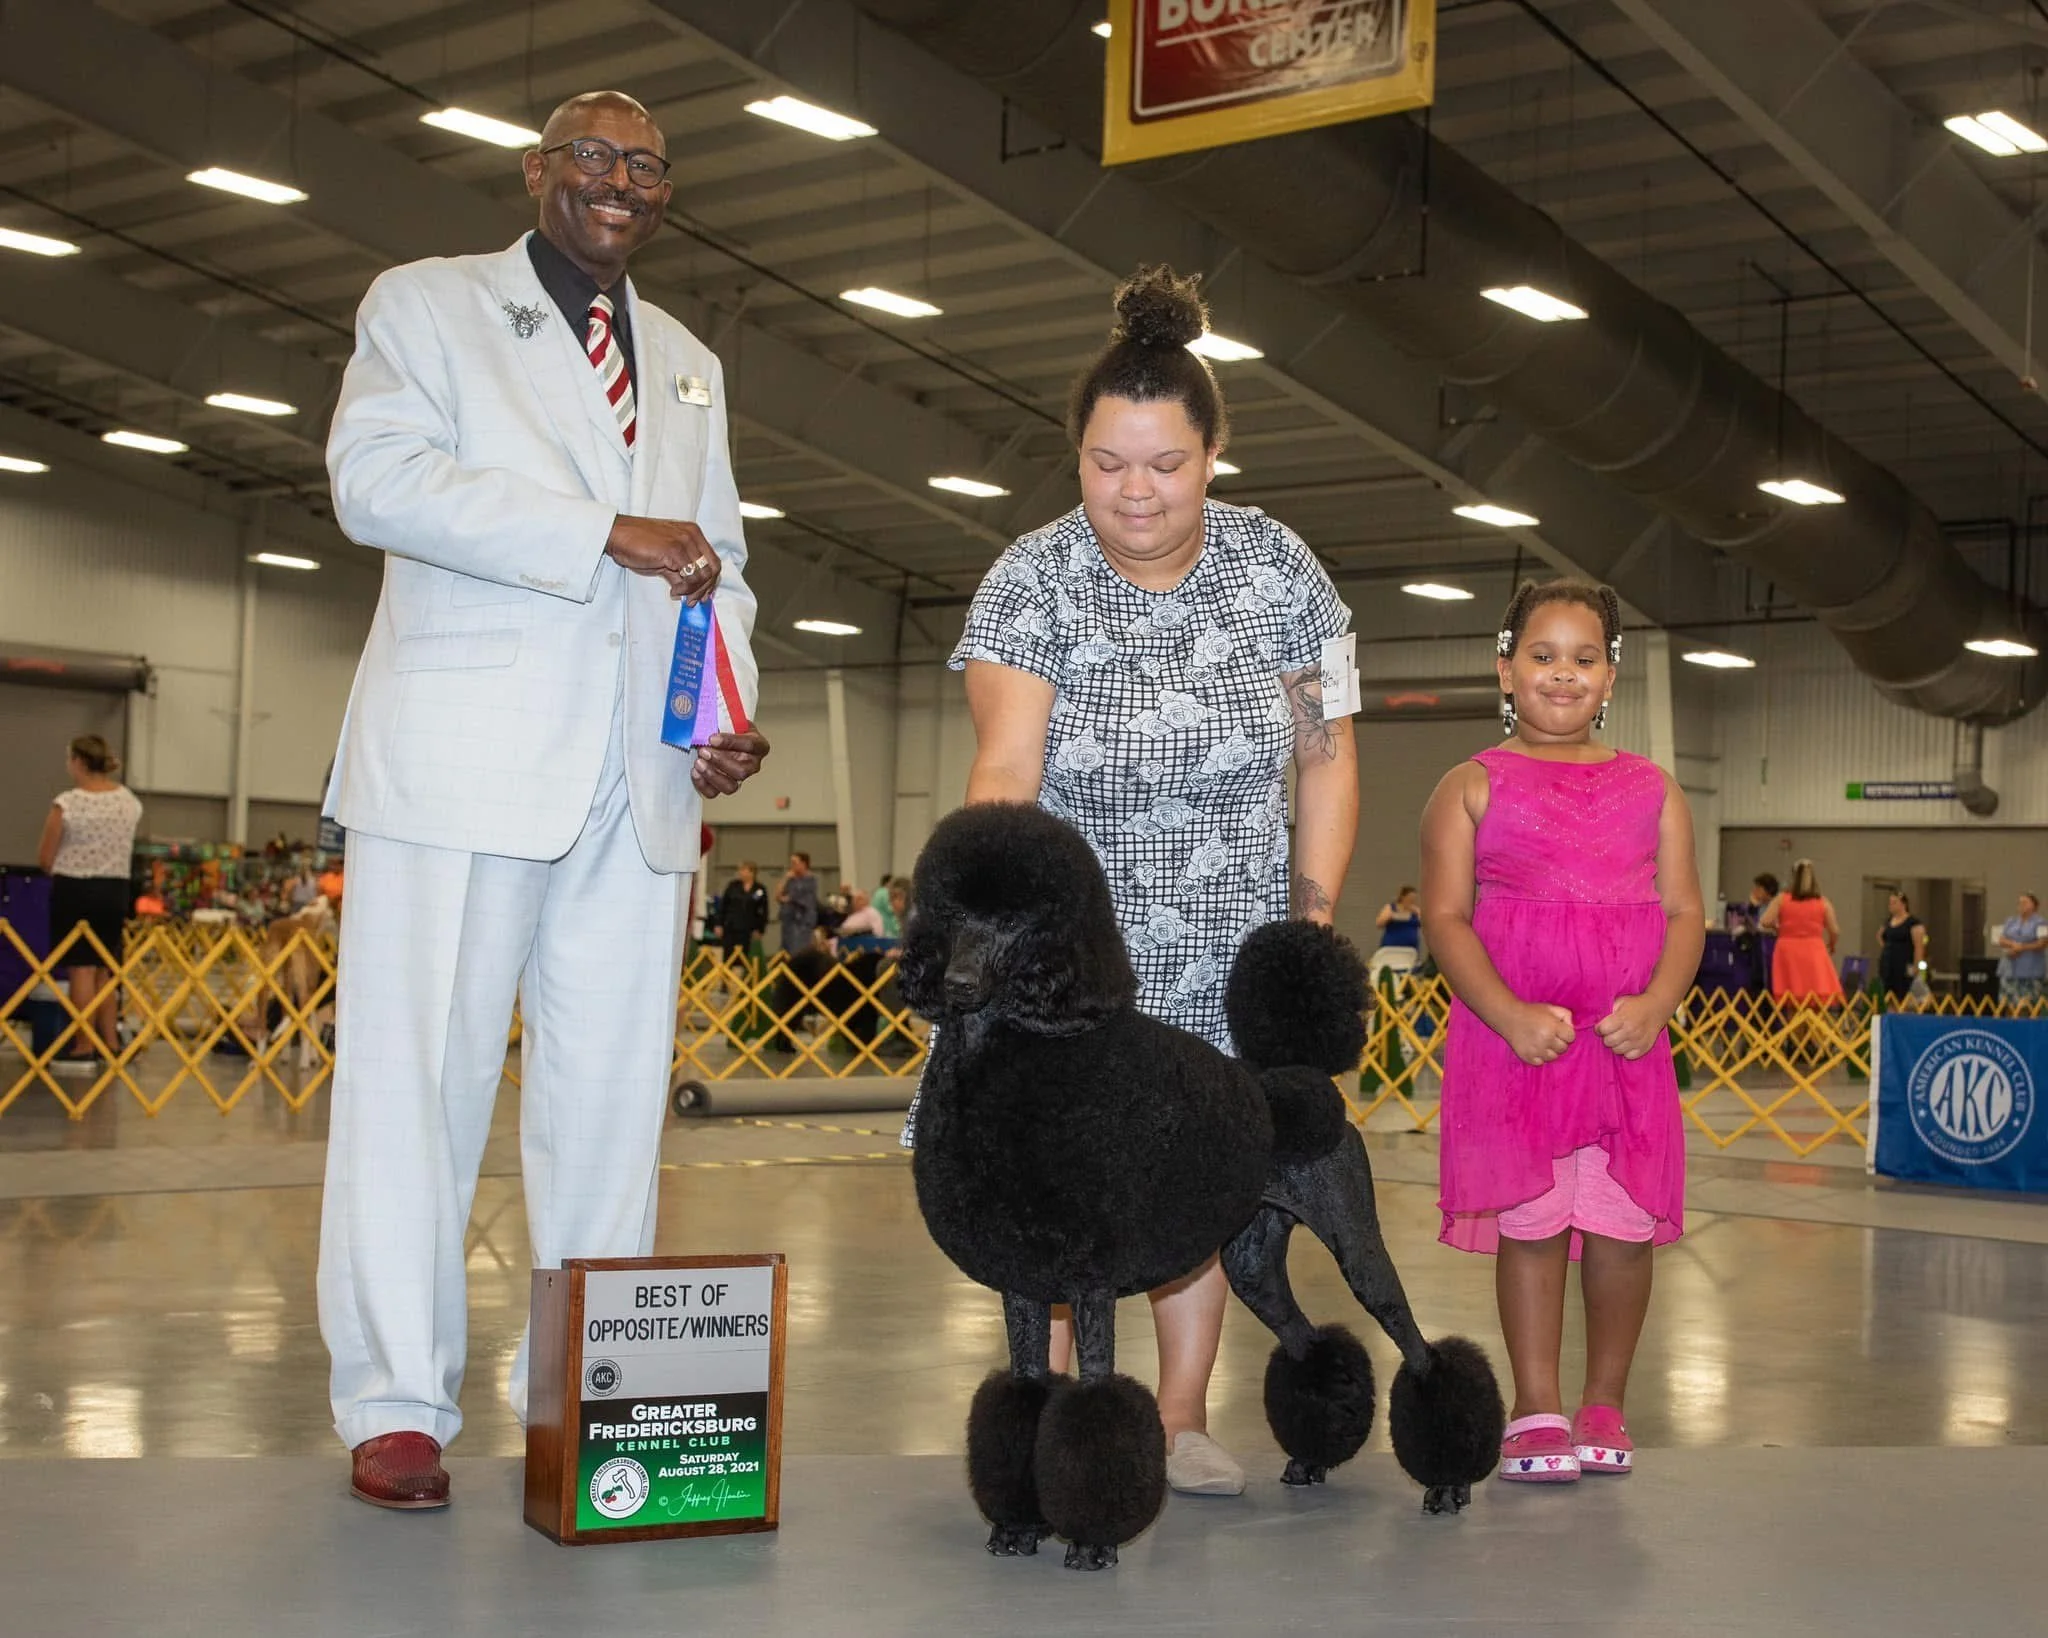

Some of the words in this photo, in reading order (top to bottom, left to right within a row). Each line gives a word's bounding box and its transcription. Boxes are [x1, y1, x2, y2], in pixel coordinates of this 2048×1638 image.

[1248, 12, 1375, 66] CENTER
[1916, 1040, 1962, 1101] AMERICAN
[1965, 1038, 2016, 1072] KENNEL
[2012, 1071, 2027, 1112] CLUB
[1934, 1058, 2005, 1138] AKC
[635, 1285, 692, 1308] BEST
[701, 1284, 728, 1306] OF
[588, 1314, 769, 1342] OPPOSITE/WINNERS
[595, 1371, 612, 1384] AKC
[631, 1403, 717, 1421] GREATER
[589, 1417, 757, 1440] FREDERICKSBURG
[616, 1439, 680, 1452] KENNEL
[688, 1436, 730, 1448] CLUB
[658, 1466, 706, 1478] AUGUST
[707, 1463, 727, 1475] 28,
[730, 1461, 759, 1473] 2021
[679, 1452, 740, 1465] SATURDAY
